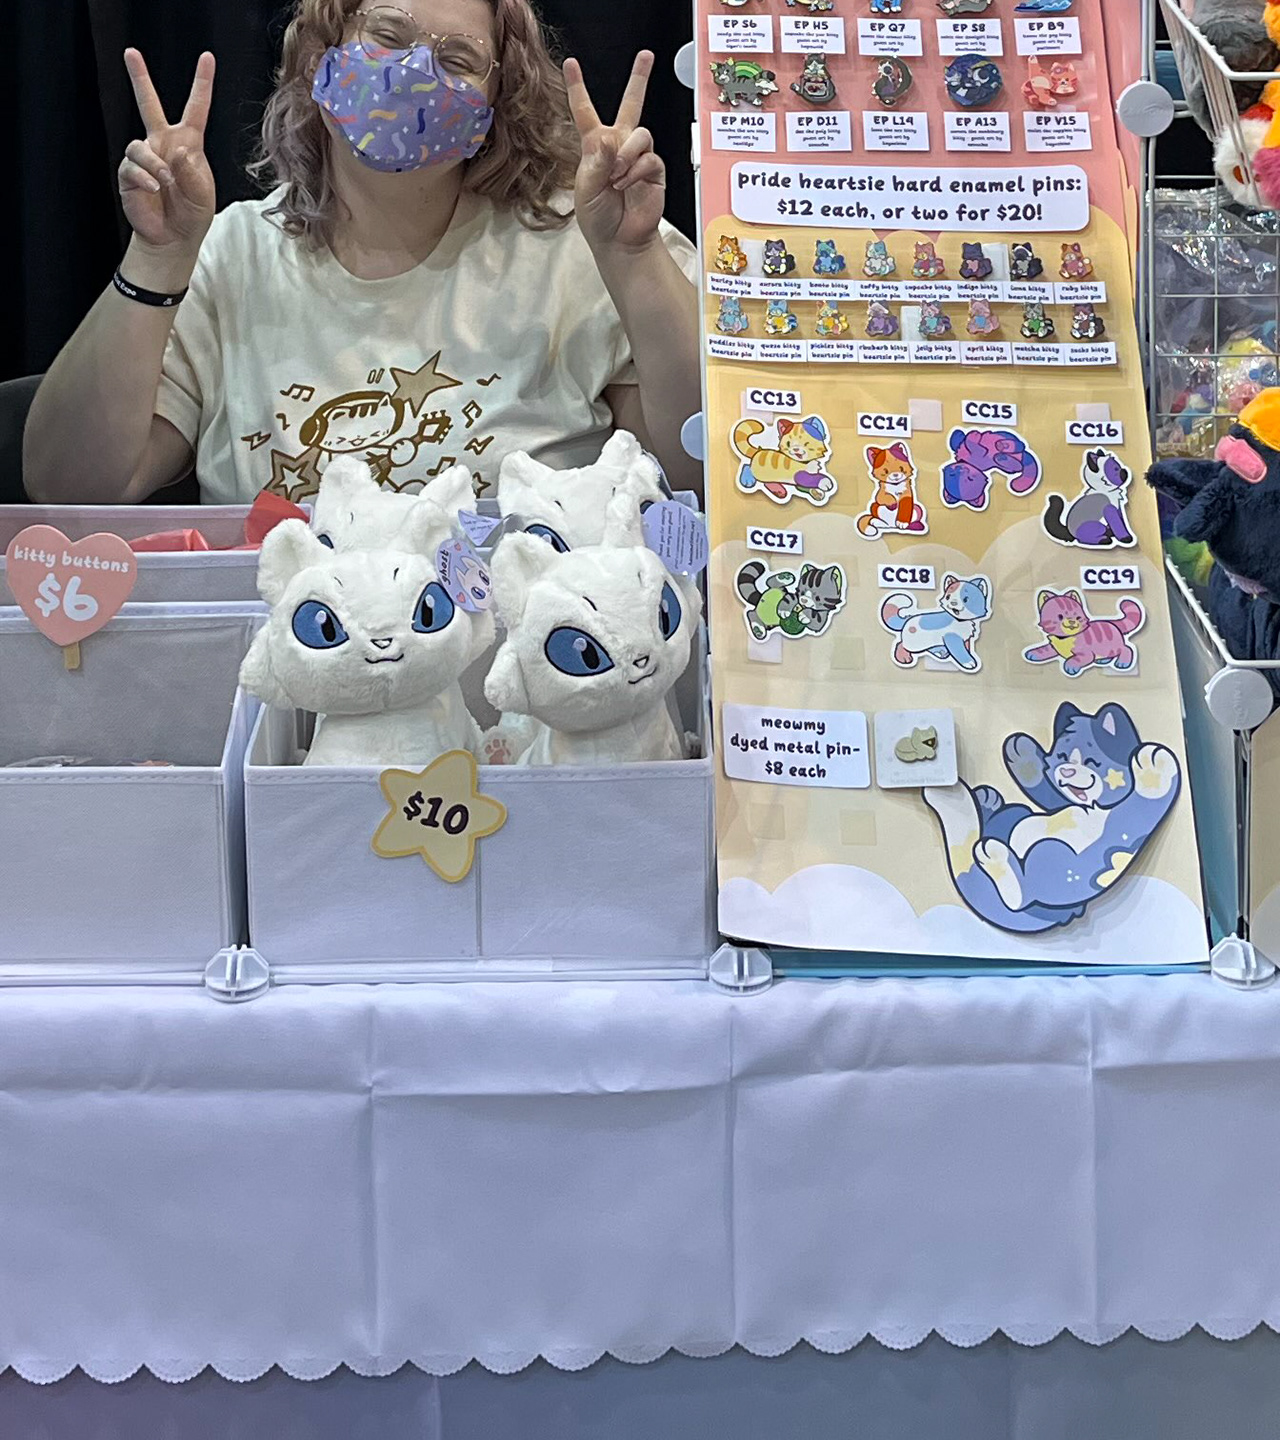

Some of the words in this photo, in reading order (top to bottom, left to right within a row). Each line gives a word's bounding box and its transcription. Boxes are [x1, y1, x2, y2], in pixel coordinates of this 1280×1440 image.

[869, 22, 886, 32] EP
[888, 22, 906, 33] Q7
[1028, 22, 1044, 32] EP
[1047, 21, 1065, 31] B9
[721, 115, 737, 126] EP
[740, 116, 765, 127] M10
[797, 116, 814, 127] EP
[816, 115, 838, 127] D11
[738, 171, 792, 190] pride
[798, 172, 885, 192] heartsie
[892, 174, 943, 193] hard
[949, 175, 1026, 193] enamel
[1032, 175, 1082, 198] pins:
[776, 198, 814, 216] $12
[820, 201, 876, 221] each,
[882, 206, 905, 220] or
[911, 205, 949, 221] two
[955, 203, 991, 222] for
[996, 203, 1043, 222] $20!
[750, 389, 797, 407] CC13
[965, 401, 1013, 420] CC15
[859, 414, 908, 432] CC14
[1069, 422, 1119, 438] CC16
[750, 529, 798, 549] CC17
[14, 545, 56, 568] kitty
[61, 551, 130, 573] buttons
[440, 548, 451, 586] ghost
[881, 566, 931, 584] CC18
[1083, 568, 1135, 585] CC19
[34, 572, 99, 622] $6
[760, 717, 826, 734] meowmy
[730, 732, 769, 753] dyed
[773, 740, 821, 755] metal
[826, 741, 861, 759] pin-
[764, 760, 784, 776] $8
[788, 763, 827, 779] each
[402, 790, 470, 835] $10
